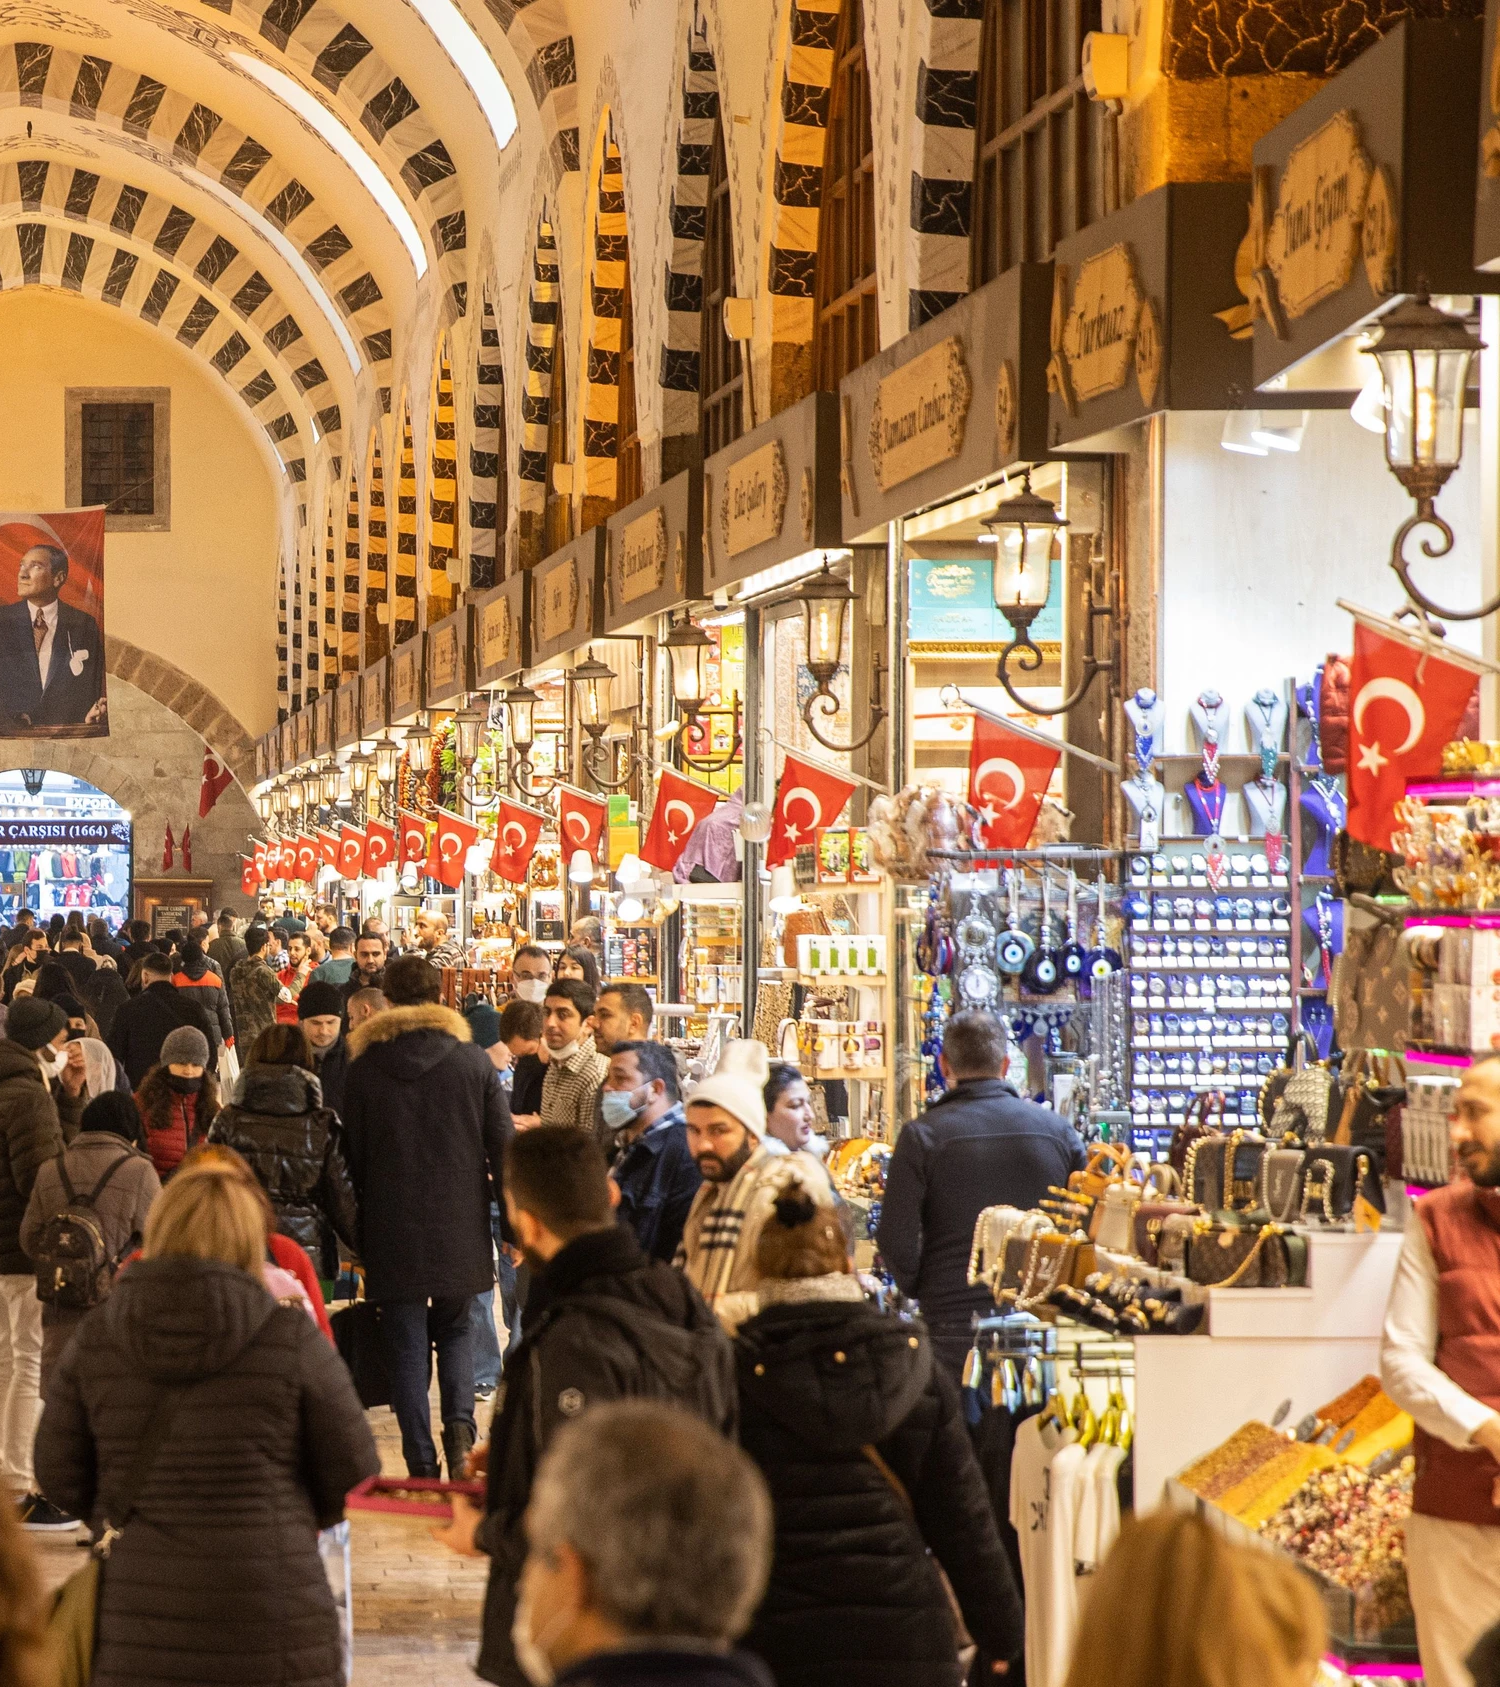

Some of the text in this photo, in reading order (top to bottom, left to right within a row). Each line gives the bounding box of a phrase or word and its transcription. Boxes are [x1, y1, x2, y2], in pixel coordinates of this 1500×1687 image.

[1077, 293, 1124, 358] Turkuaz
[66, 796, 116, 810] EXPORT
[8, 825, 66, 839] ÇARŞISI
[69, 825, 108, 838] (1664)
